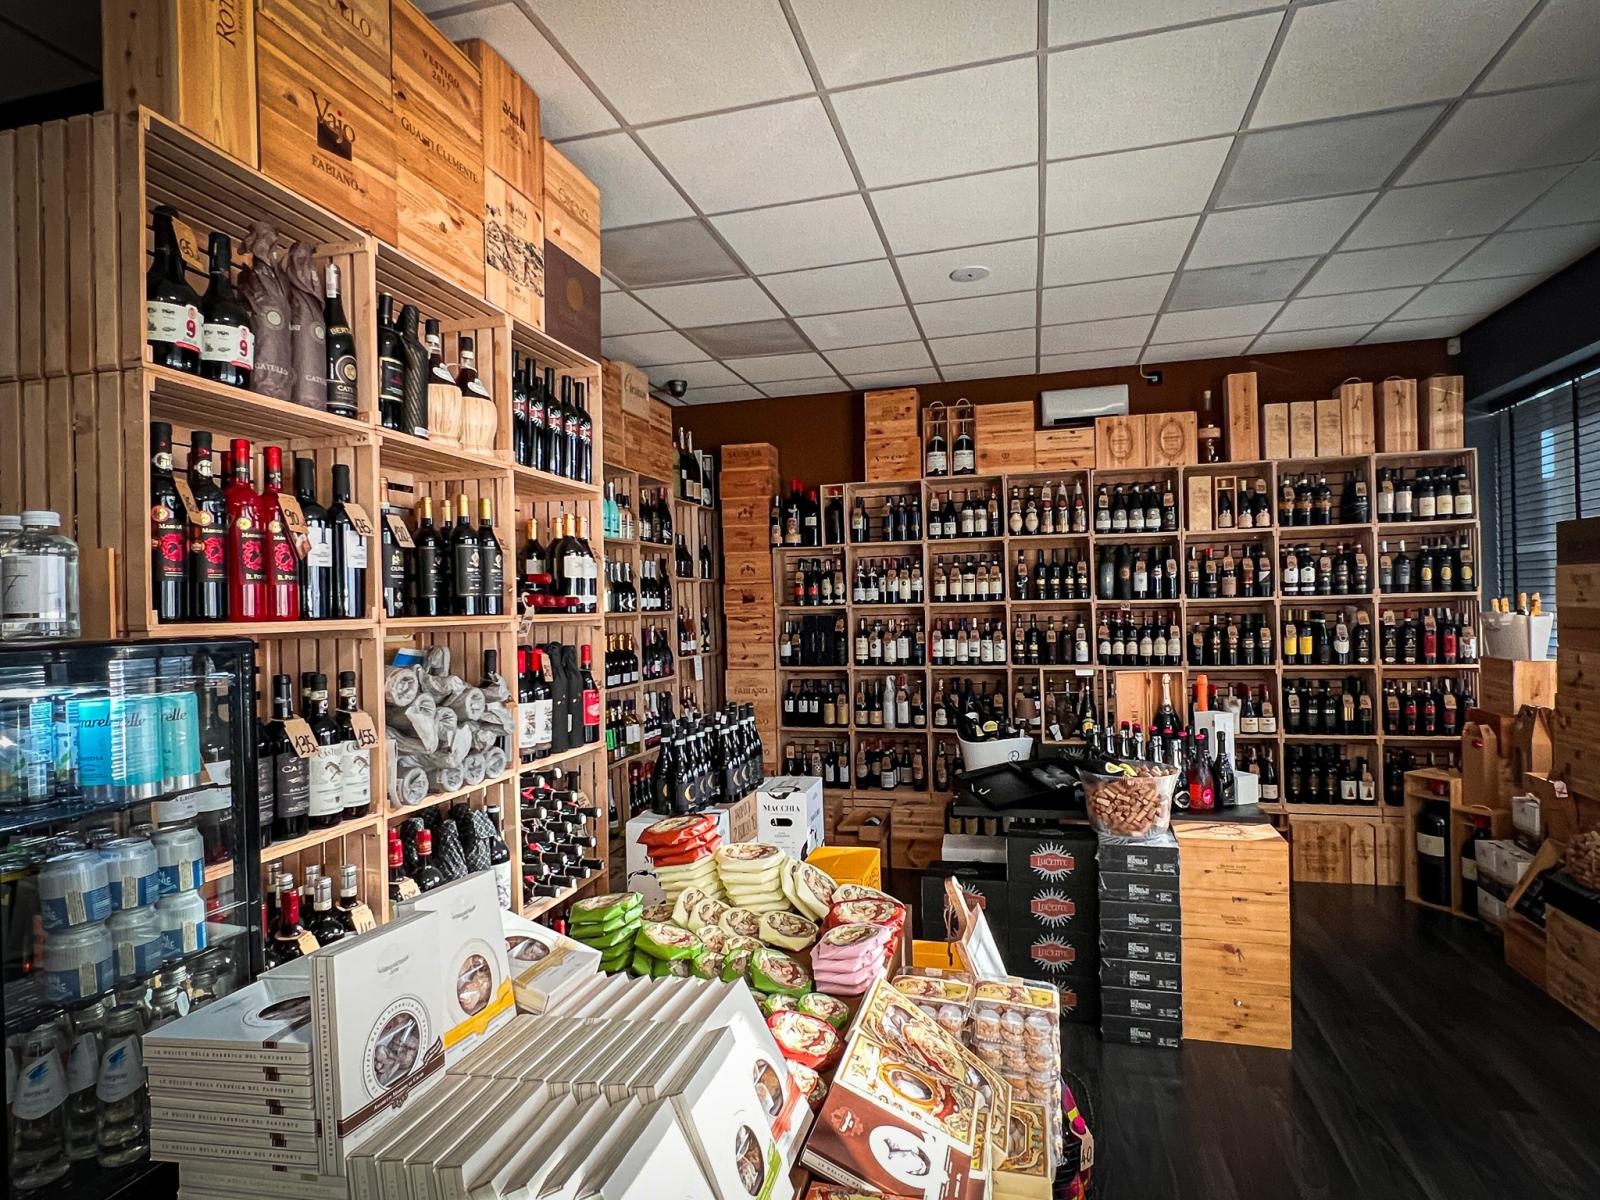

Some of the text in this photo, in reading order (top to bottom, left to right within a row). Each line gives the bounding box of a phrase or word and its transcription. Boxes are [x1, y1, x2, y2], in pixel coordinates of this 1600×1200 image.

[311, 153, 359, 193] FABIANO
[436, 143, 479, 184] CLEMENTE
[763, 804, 800, 812] MACCHIA
[1037, 857, 1068, 867] LUCENTE
